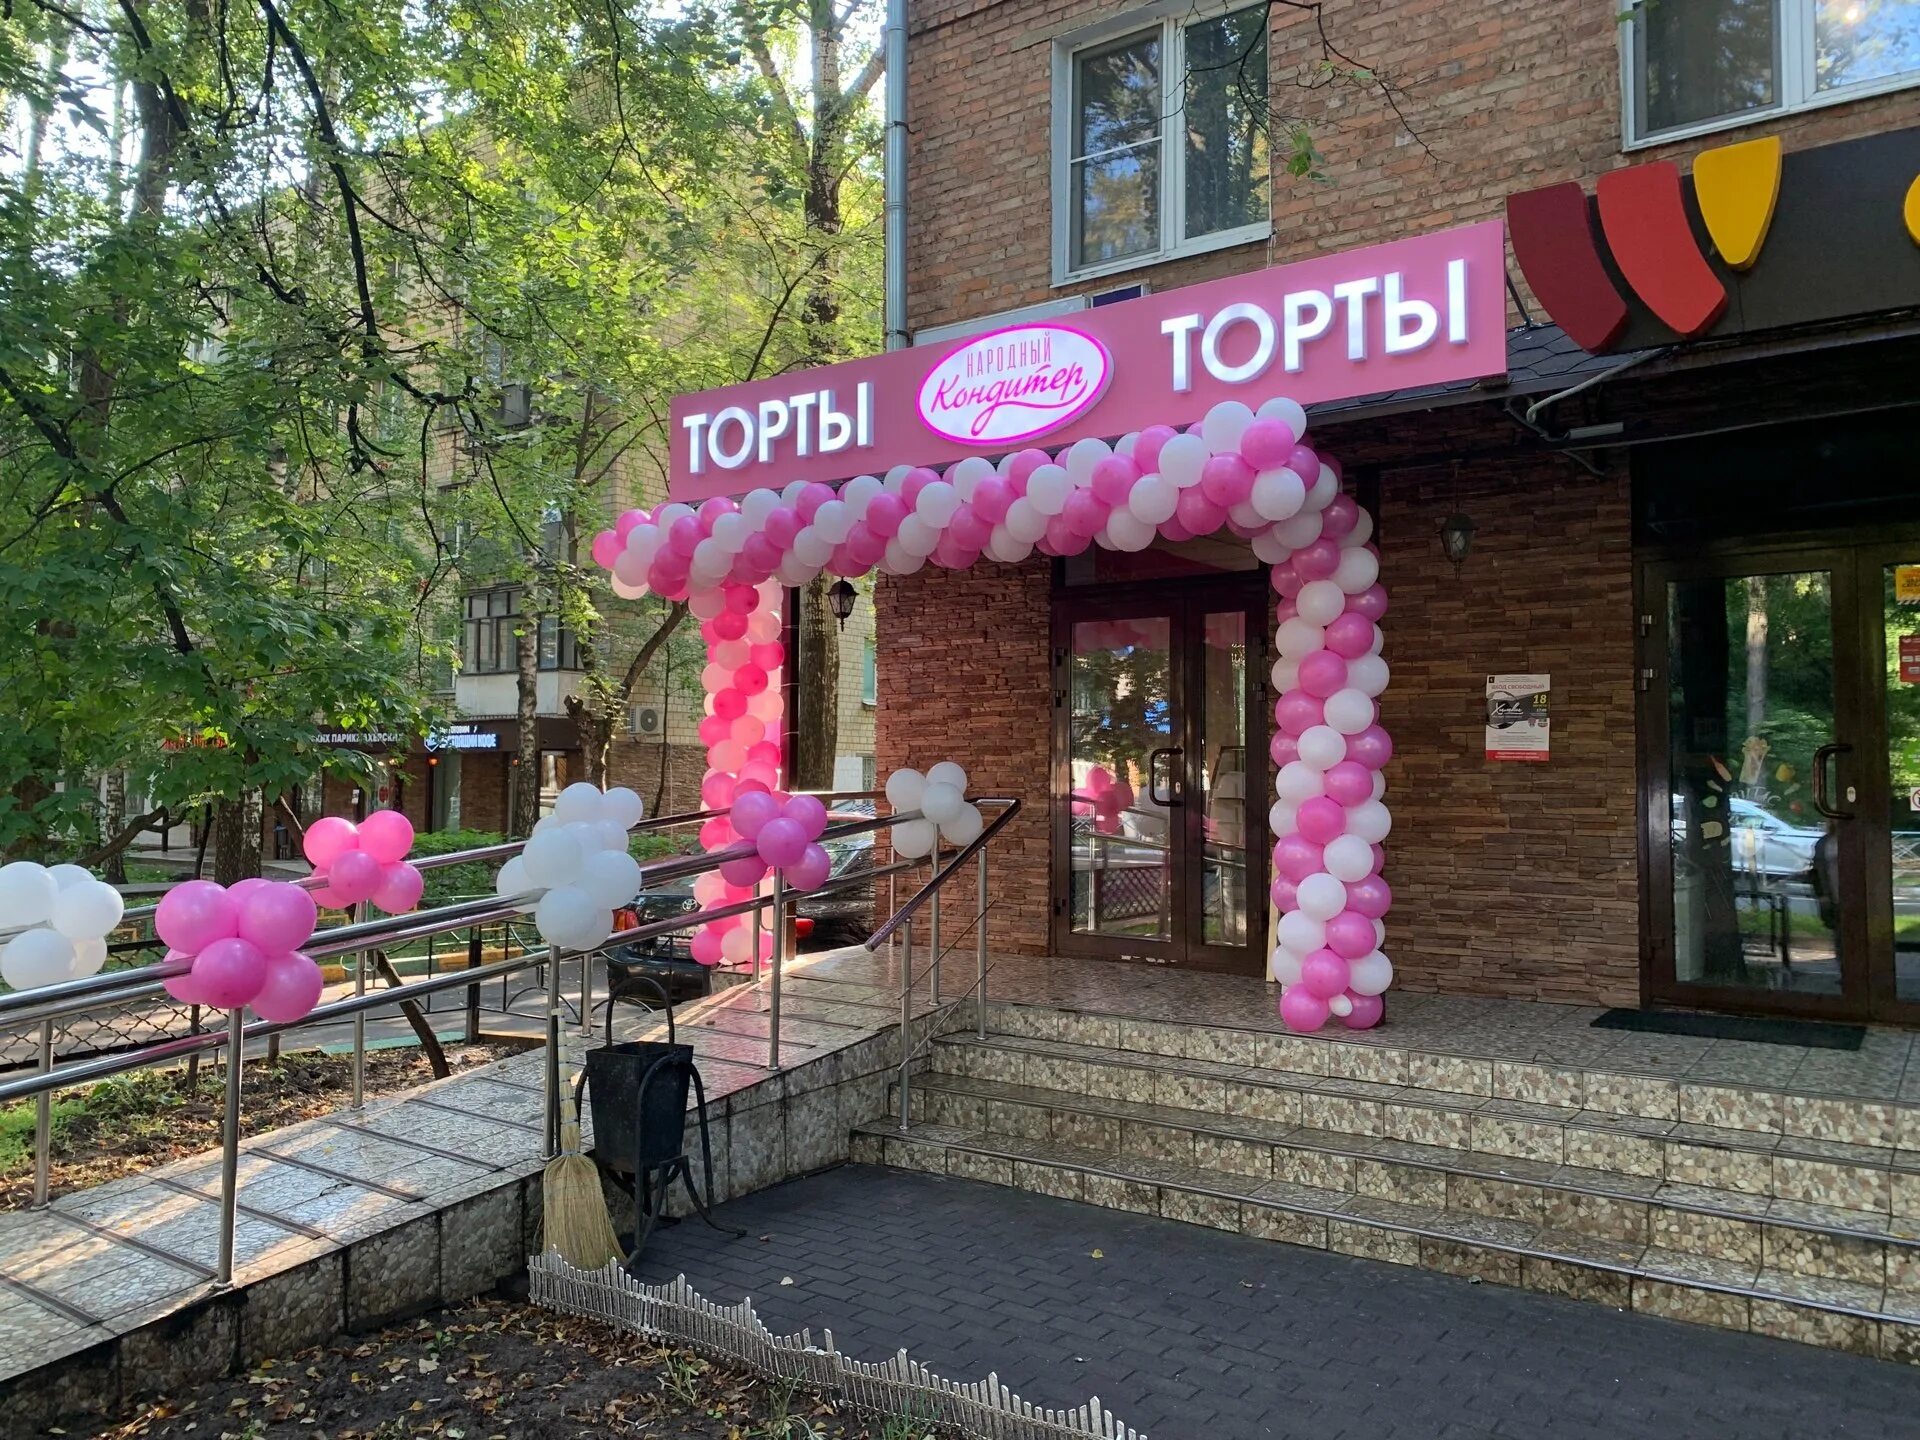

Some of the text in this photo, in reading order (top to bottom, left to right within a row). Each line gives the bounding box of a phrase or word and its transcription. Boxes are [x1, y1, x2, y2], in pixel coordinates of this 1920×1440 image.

[966, 331, 1052, 378] НАРОДНЫЙ
[1161, 258, 1468, 393] ТОРТЫ
[682, 381, 874, 475] ТОРТЫ
[930, 361, 1088, 437] Кондитер
[1533, 694, 1547, 704] 18
